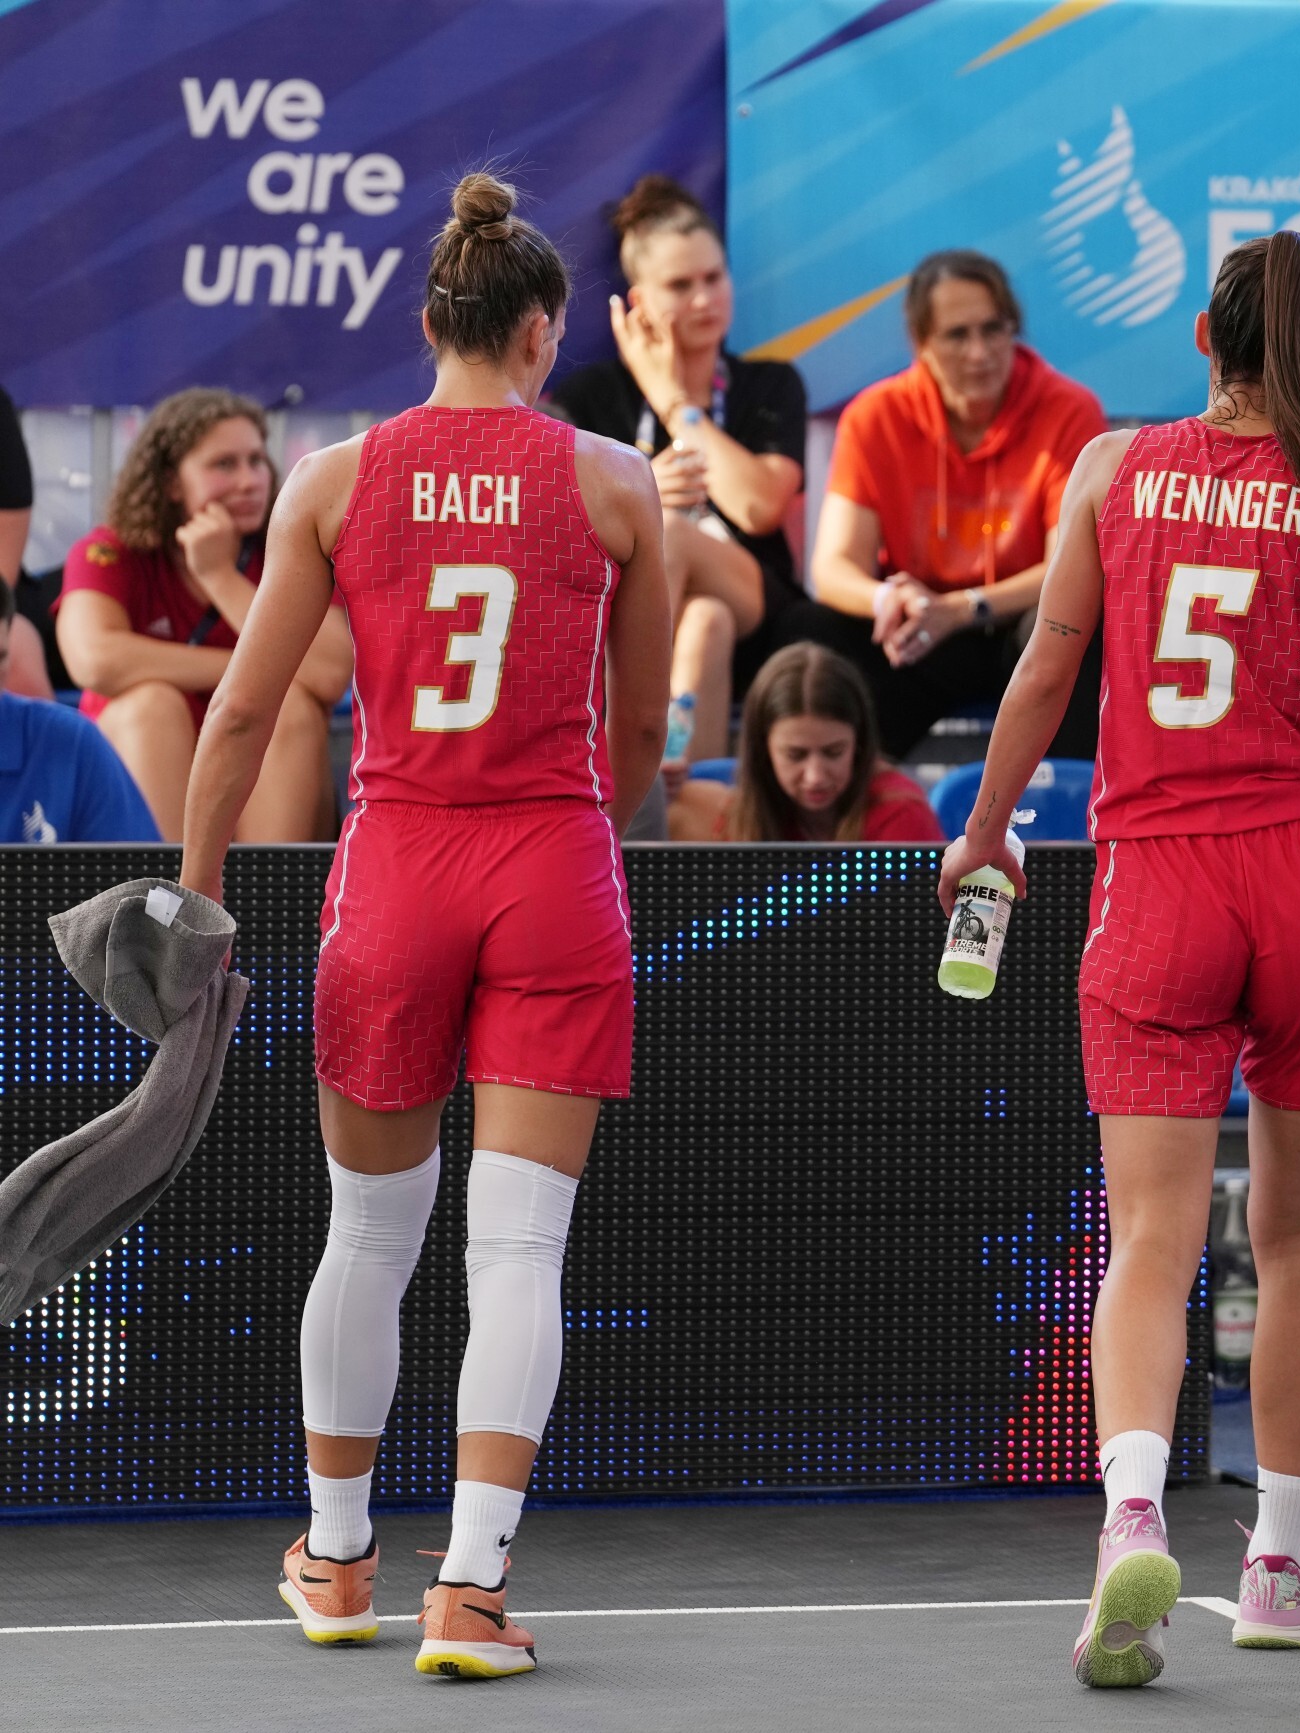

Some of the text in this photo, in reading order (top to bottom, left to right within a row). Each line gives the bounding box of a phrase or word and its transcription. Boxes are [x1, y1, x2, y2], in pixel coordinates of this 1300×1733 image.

[181, 77, 325, 142] we
[247, 150, 405, 216] are
[182, 222, 403, 330] unity
[413, 472, 520, 525] BACH
[411, 563, 519, 732] 3
[1147, 563, 1260, 729] 5
